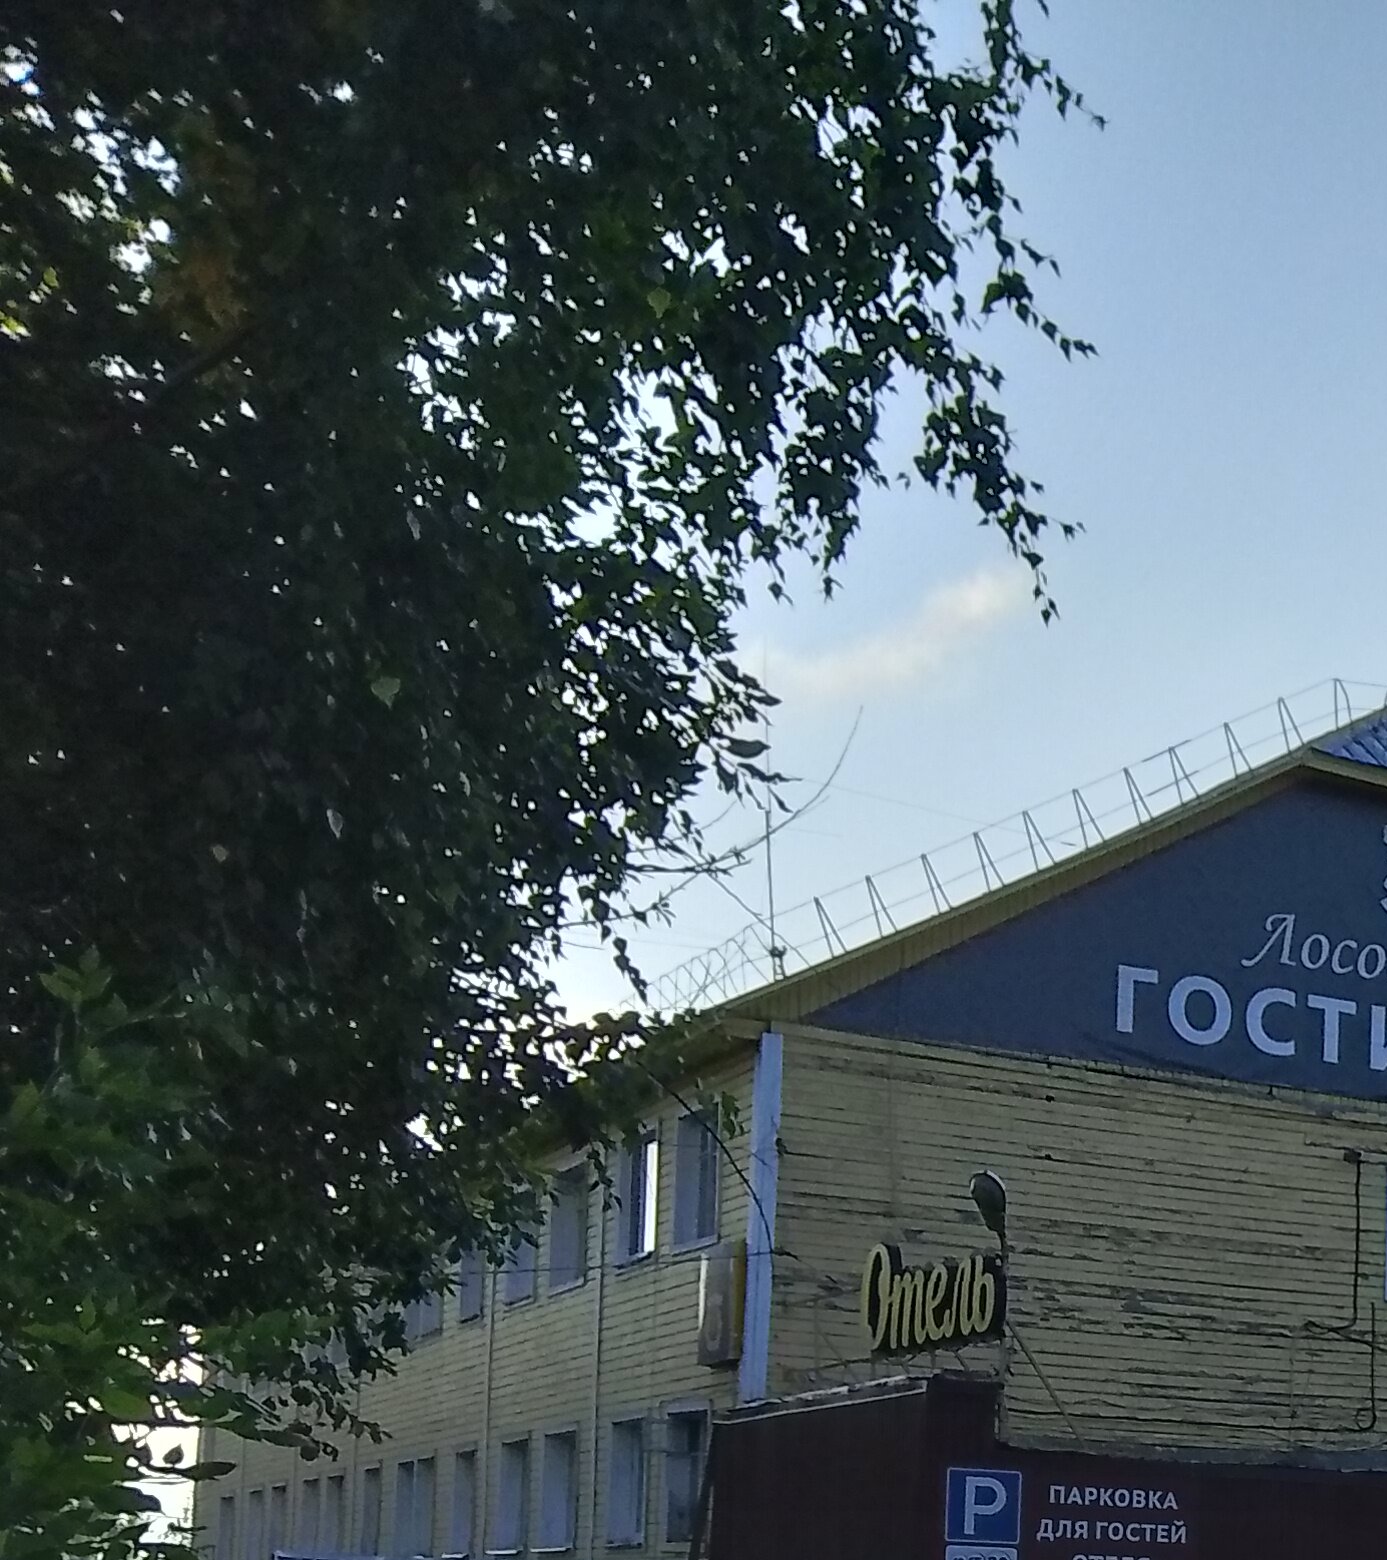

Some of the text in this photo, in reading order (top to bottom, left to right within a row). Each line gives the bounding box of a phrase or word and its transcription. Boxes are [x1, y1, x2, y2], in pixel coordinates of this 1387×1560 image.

[863, 1243, 996, 1350] Отель
[1049, 1484, 1179, 1510] ПАРКОВКА
[1036, 1518, 1188, 1544] ДЛЯ ГОСТЕЙ
